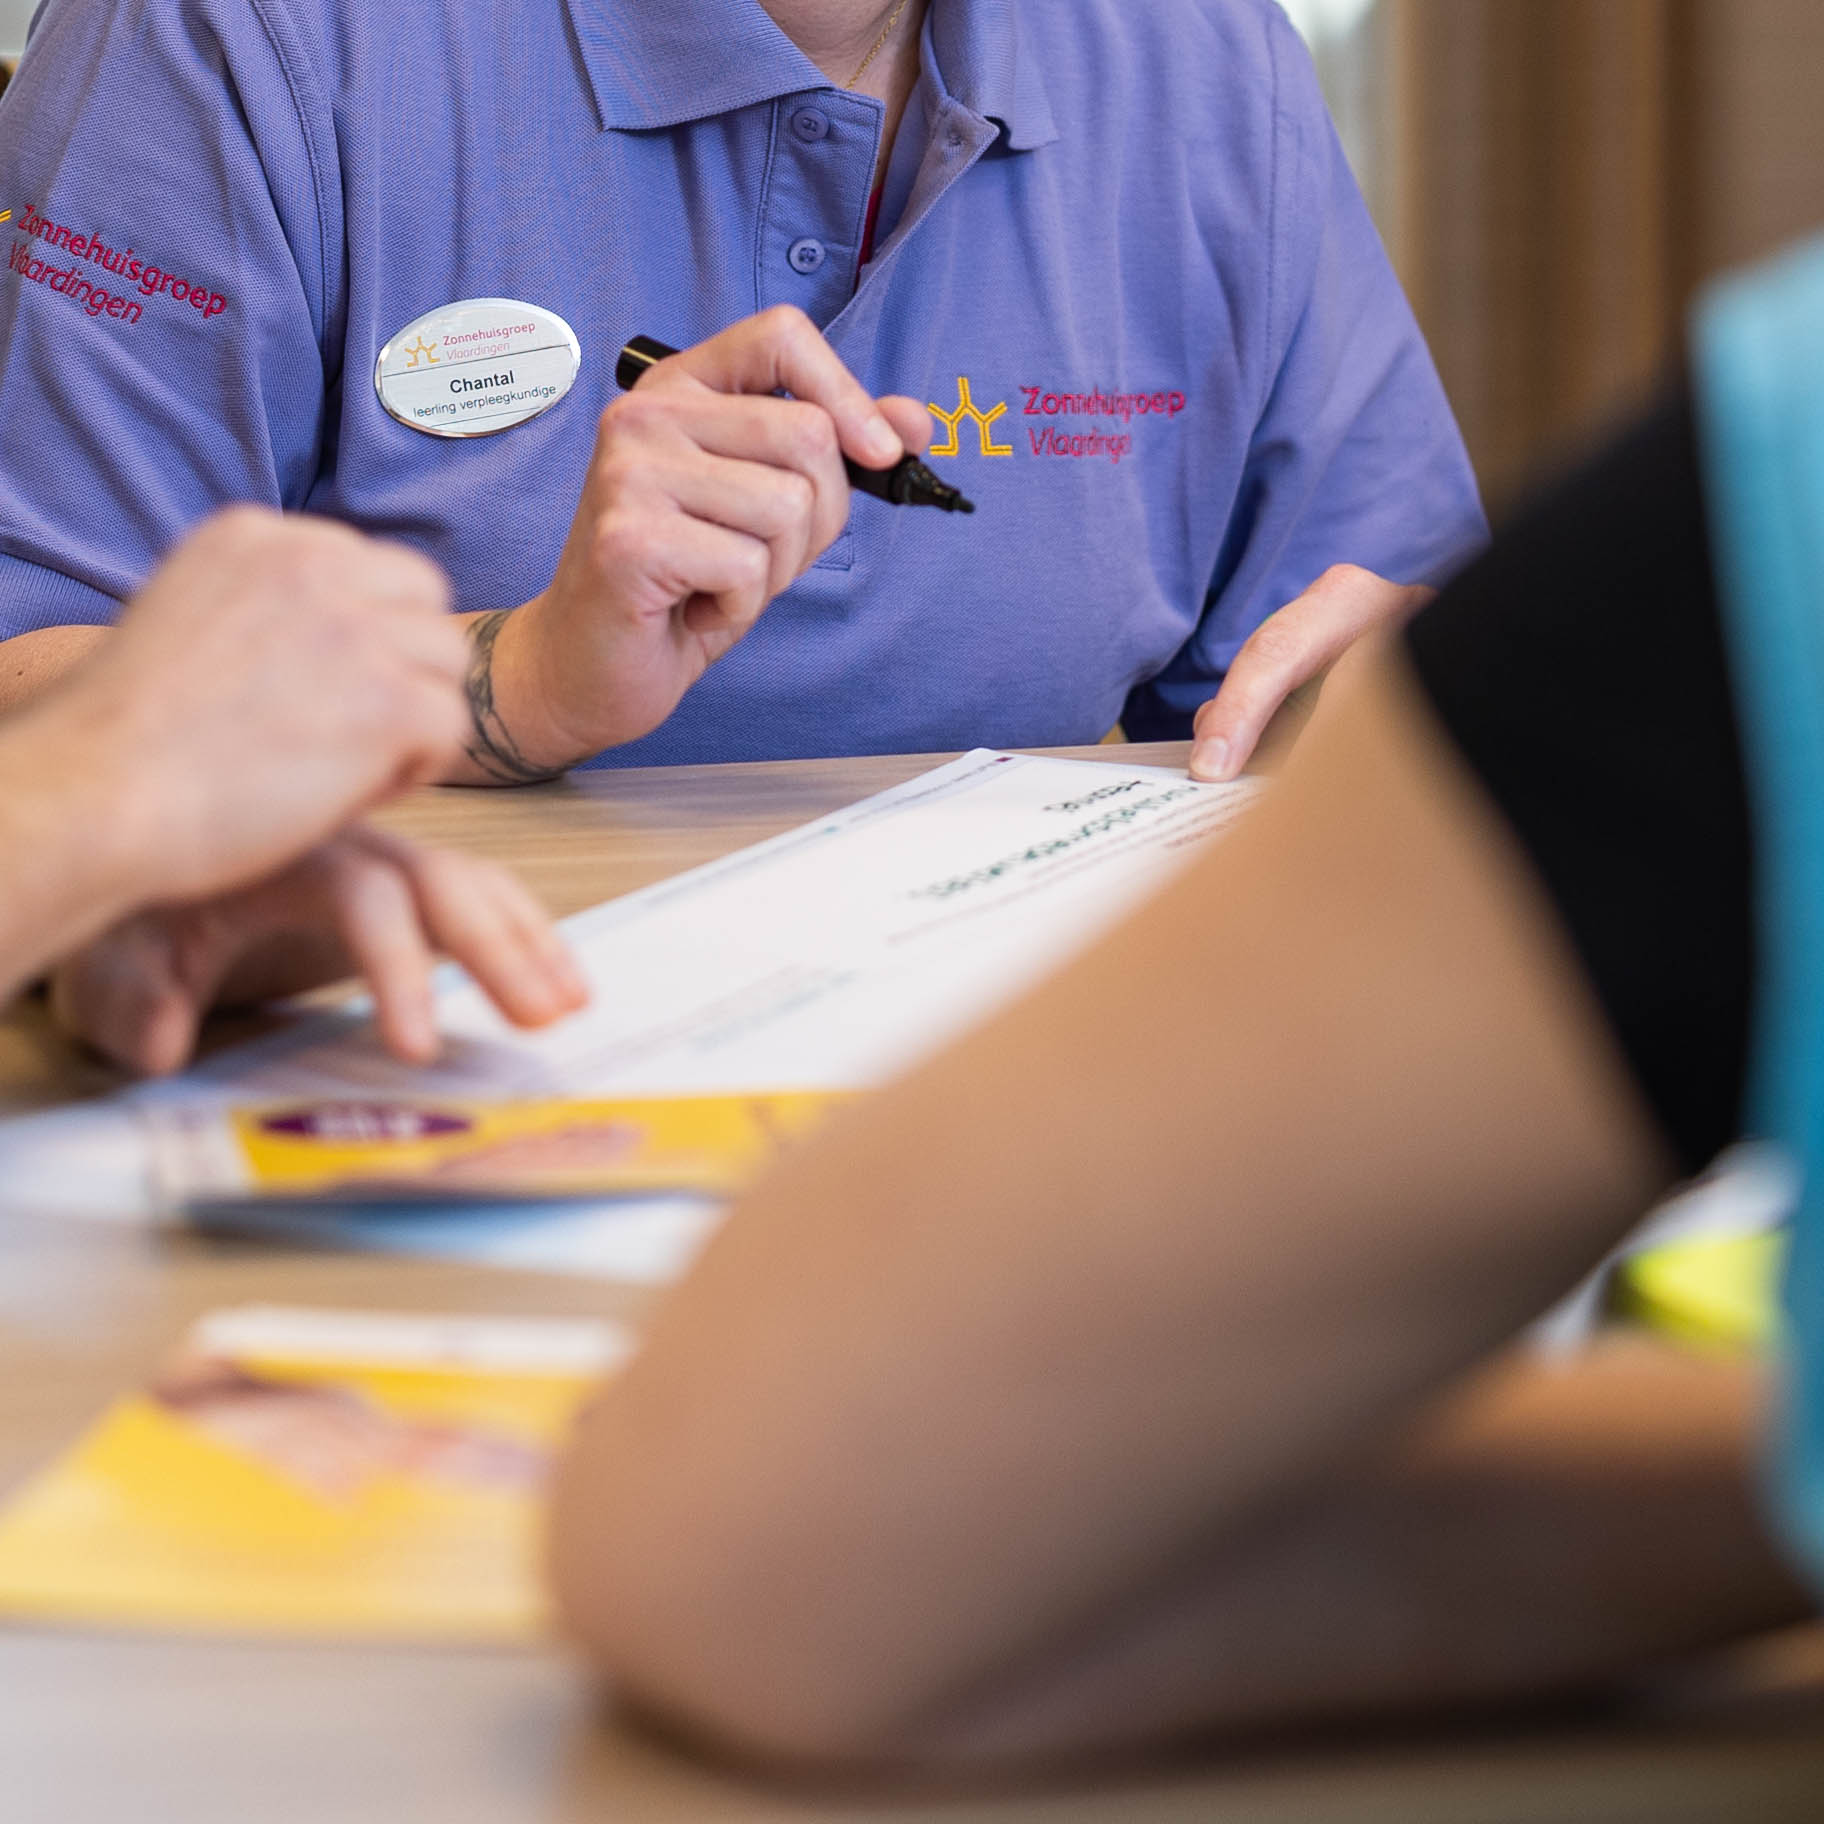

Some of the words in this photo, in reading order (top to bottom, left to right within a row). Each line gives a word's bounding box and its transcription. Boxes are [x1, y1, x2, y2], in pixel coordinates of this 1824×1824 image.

[18, 203, 227, 318] Zonnehuisgroep
[9, 243, 143, 324] Vlaardingen
[443, 322, 536, 346] Zonnehuisgroep
[447, 342, 510, 361] Vlaardingen
[449, 370, 515, 393] Chantal
[413, 401, 457, 418] leerling
[459, 384, 557, 410] verpleegkundige
